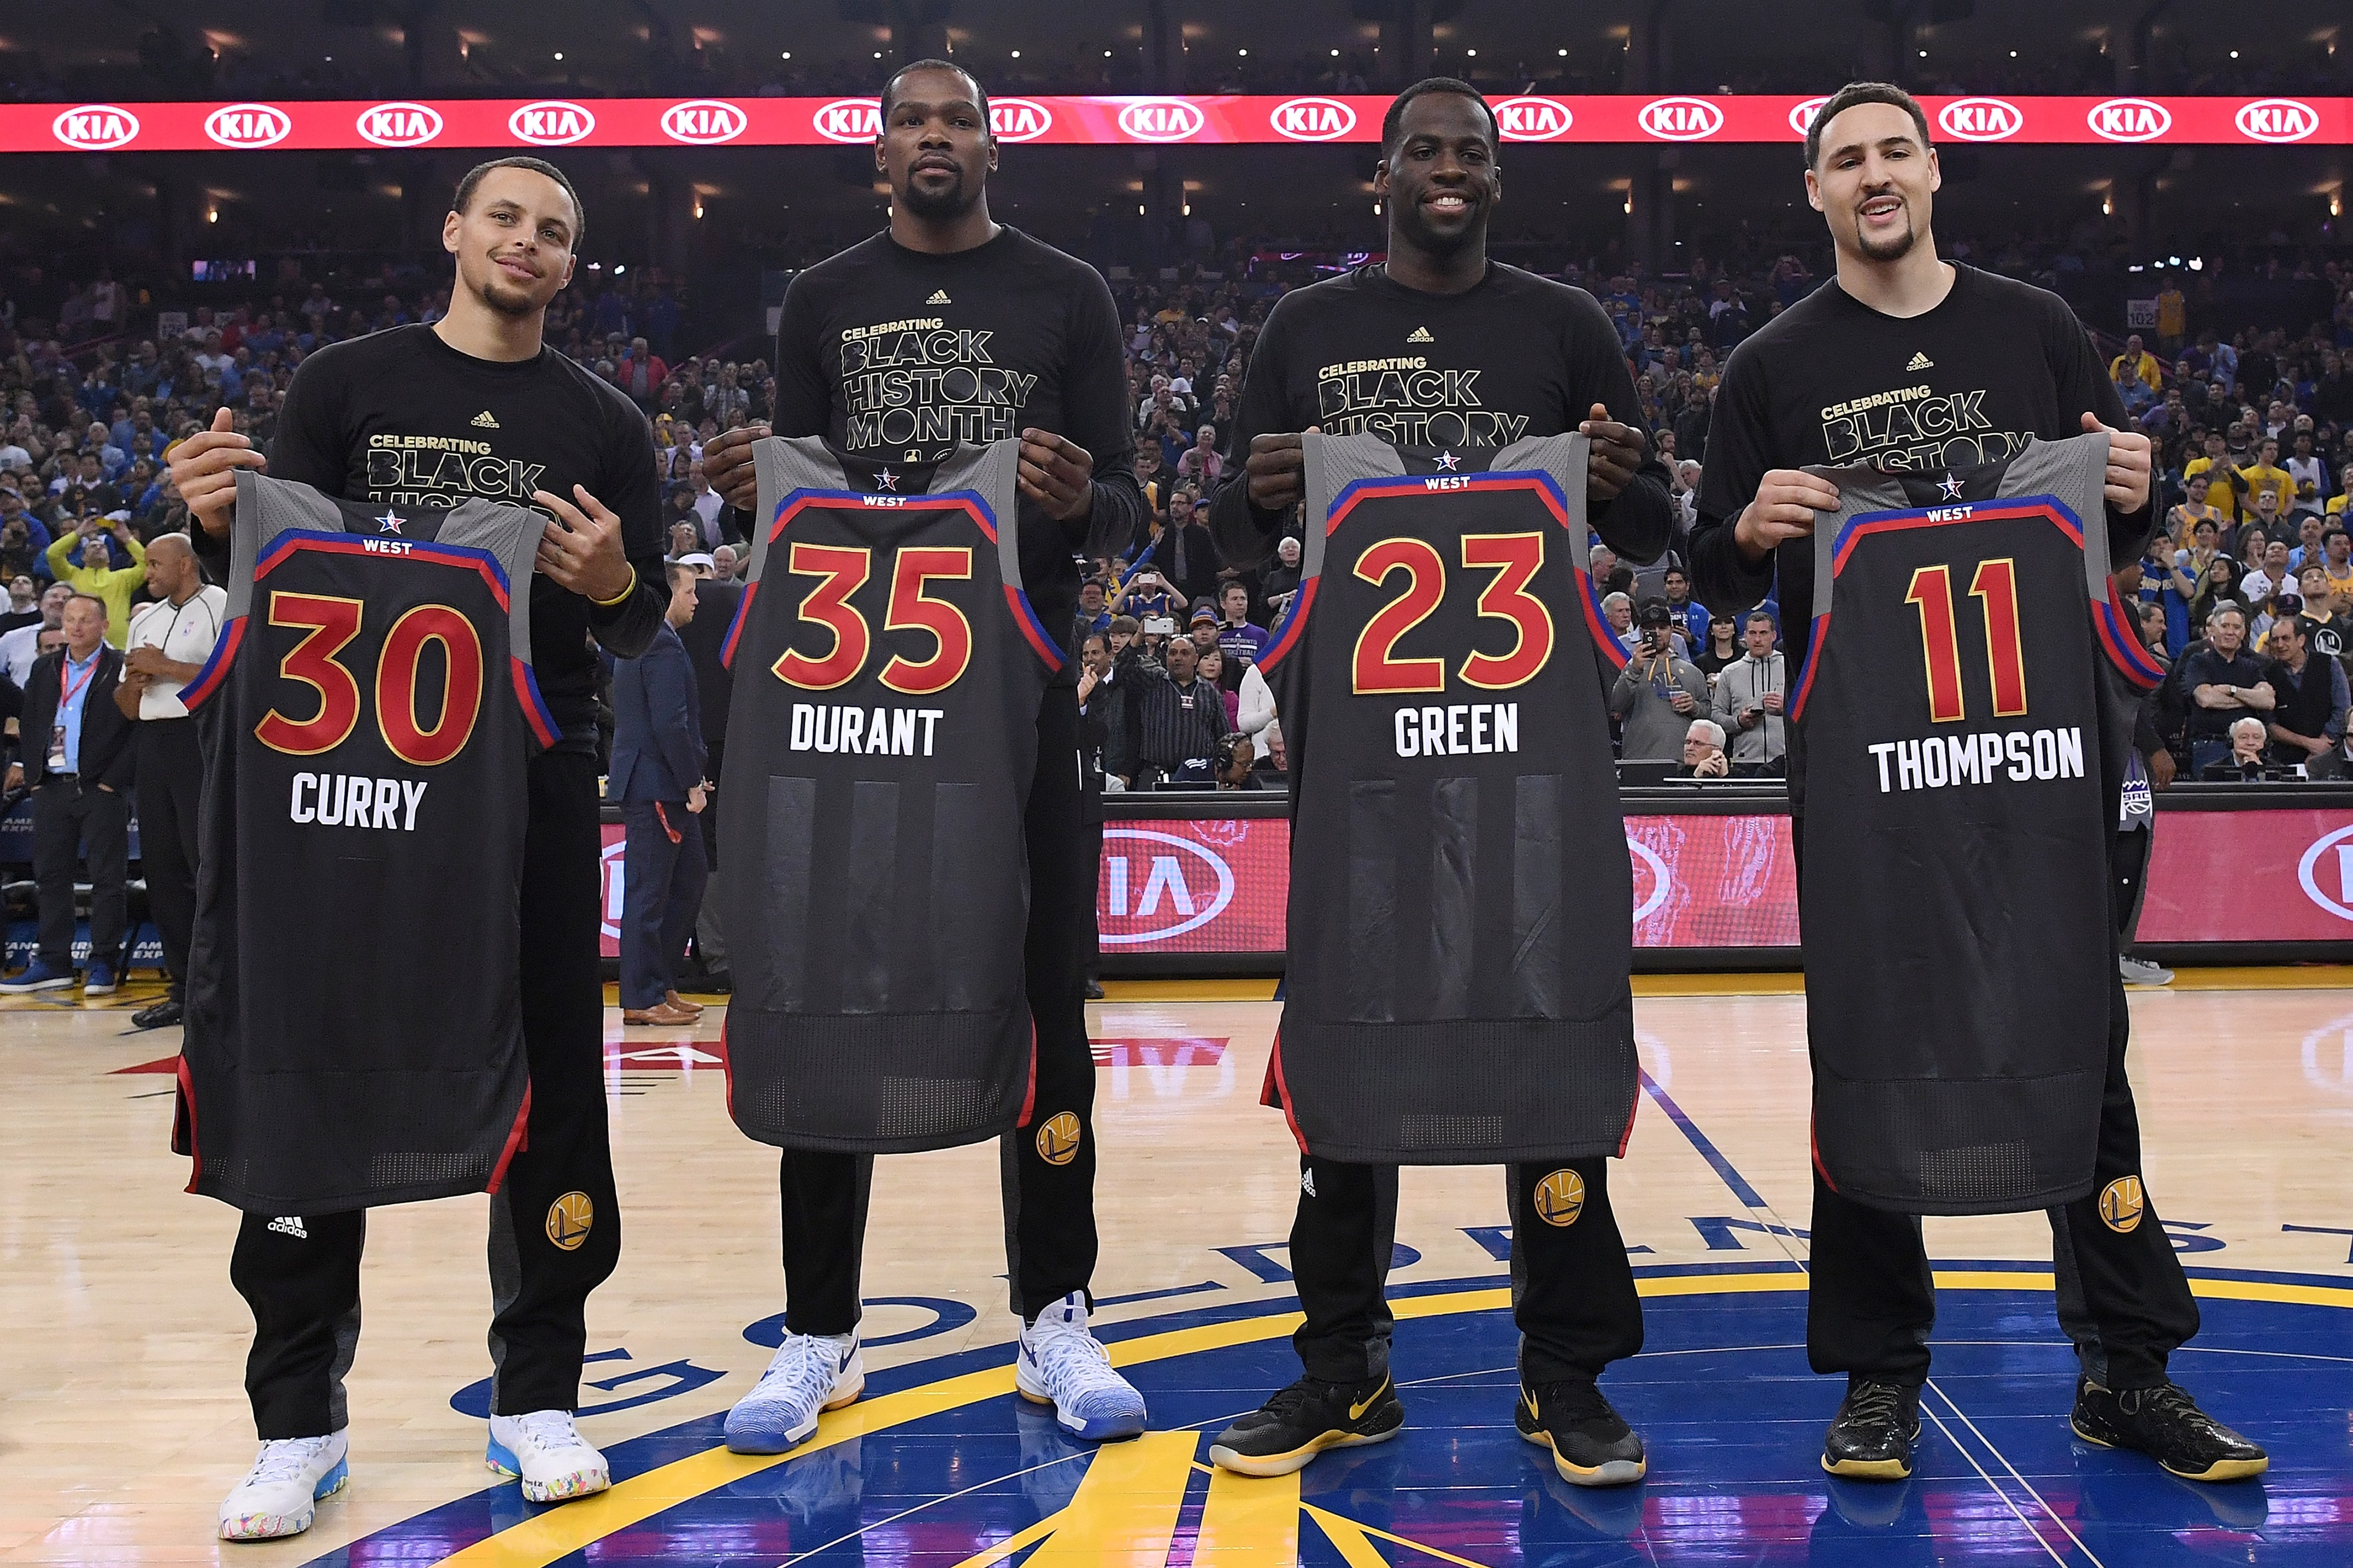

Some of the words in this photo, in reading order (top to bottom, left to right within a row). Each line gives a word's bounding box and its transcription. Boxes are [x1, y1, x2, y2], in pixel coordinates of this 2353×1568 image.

[68, 115, 125, 139] KIA
[220, 114, 277, 138] KIA
[372, 112, 429, 136] KIA
[524, 111, 581, 135] KIA
[676, 110, 733, 134] KIA
[1134, 108, 1191, 132] KIA
[1286, 108, 1342, 131] KIA
[1502, 107, 1559, 131] KIA
[1654, 107, 1710, 131] KIA
[1953, 108, 2010, 131] KIA
[2101, 109, 2158, 132] KIA
[2249, 109, 2306, 132] KIA
[842, 318, 944, 342] CELEBRATING
[841, 329, 993, 377] BLACK
[1318, 357, 1427, 379] CELEBRATING
[1906, 360, 1934, 371] adidas
[844, 366, 1038, 414] HISTORY
[1318, 370, 1482, 419] BLACK
[1821, 385, 1931, 421] CELEBRATING
[471, 419, 500, 428] adidas
[846, 405, 1015, 451] MONTH
[1822, 389, 1992, 460] BLACK
[369, 435, 491, 455] CELEBRATING
[367, 449, 546, 500] BLACK
[1425, 476, 1471, 490] WEST
[863, 496, 906, 507] WEST
[1927, 506, 1972, 523] WEST
[363, 539, 412, 555] WEST
[771, 542, 972, 695] 35
[1352, 531, 1554, 695] 23
[1904, 558, 2028, 723] 11
[254, 590, 483, 766] 30
[790, 704, 944, 756] DURANT
[1395, 703, 1518, 758] GREEN
[1868, 727, 2084, 793] THOMPSON
[291, 772, 428, 831] CURRY
[1096, 856, 1195, 916] IA
[268, 1222, 307, 1239] adidas
